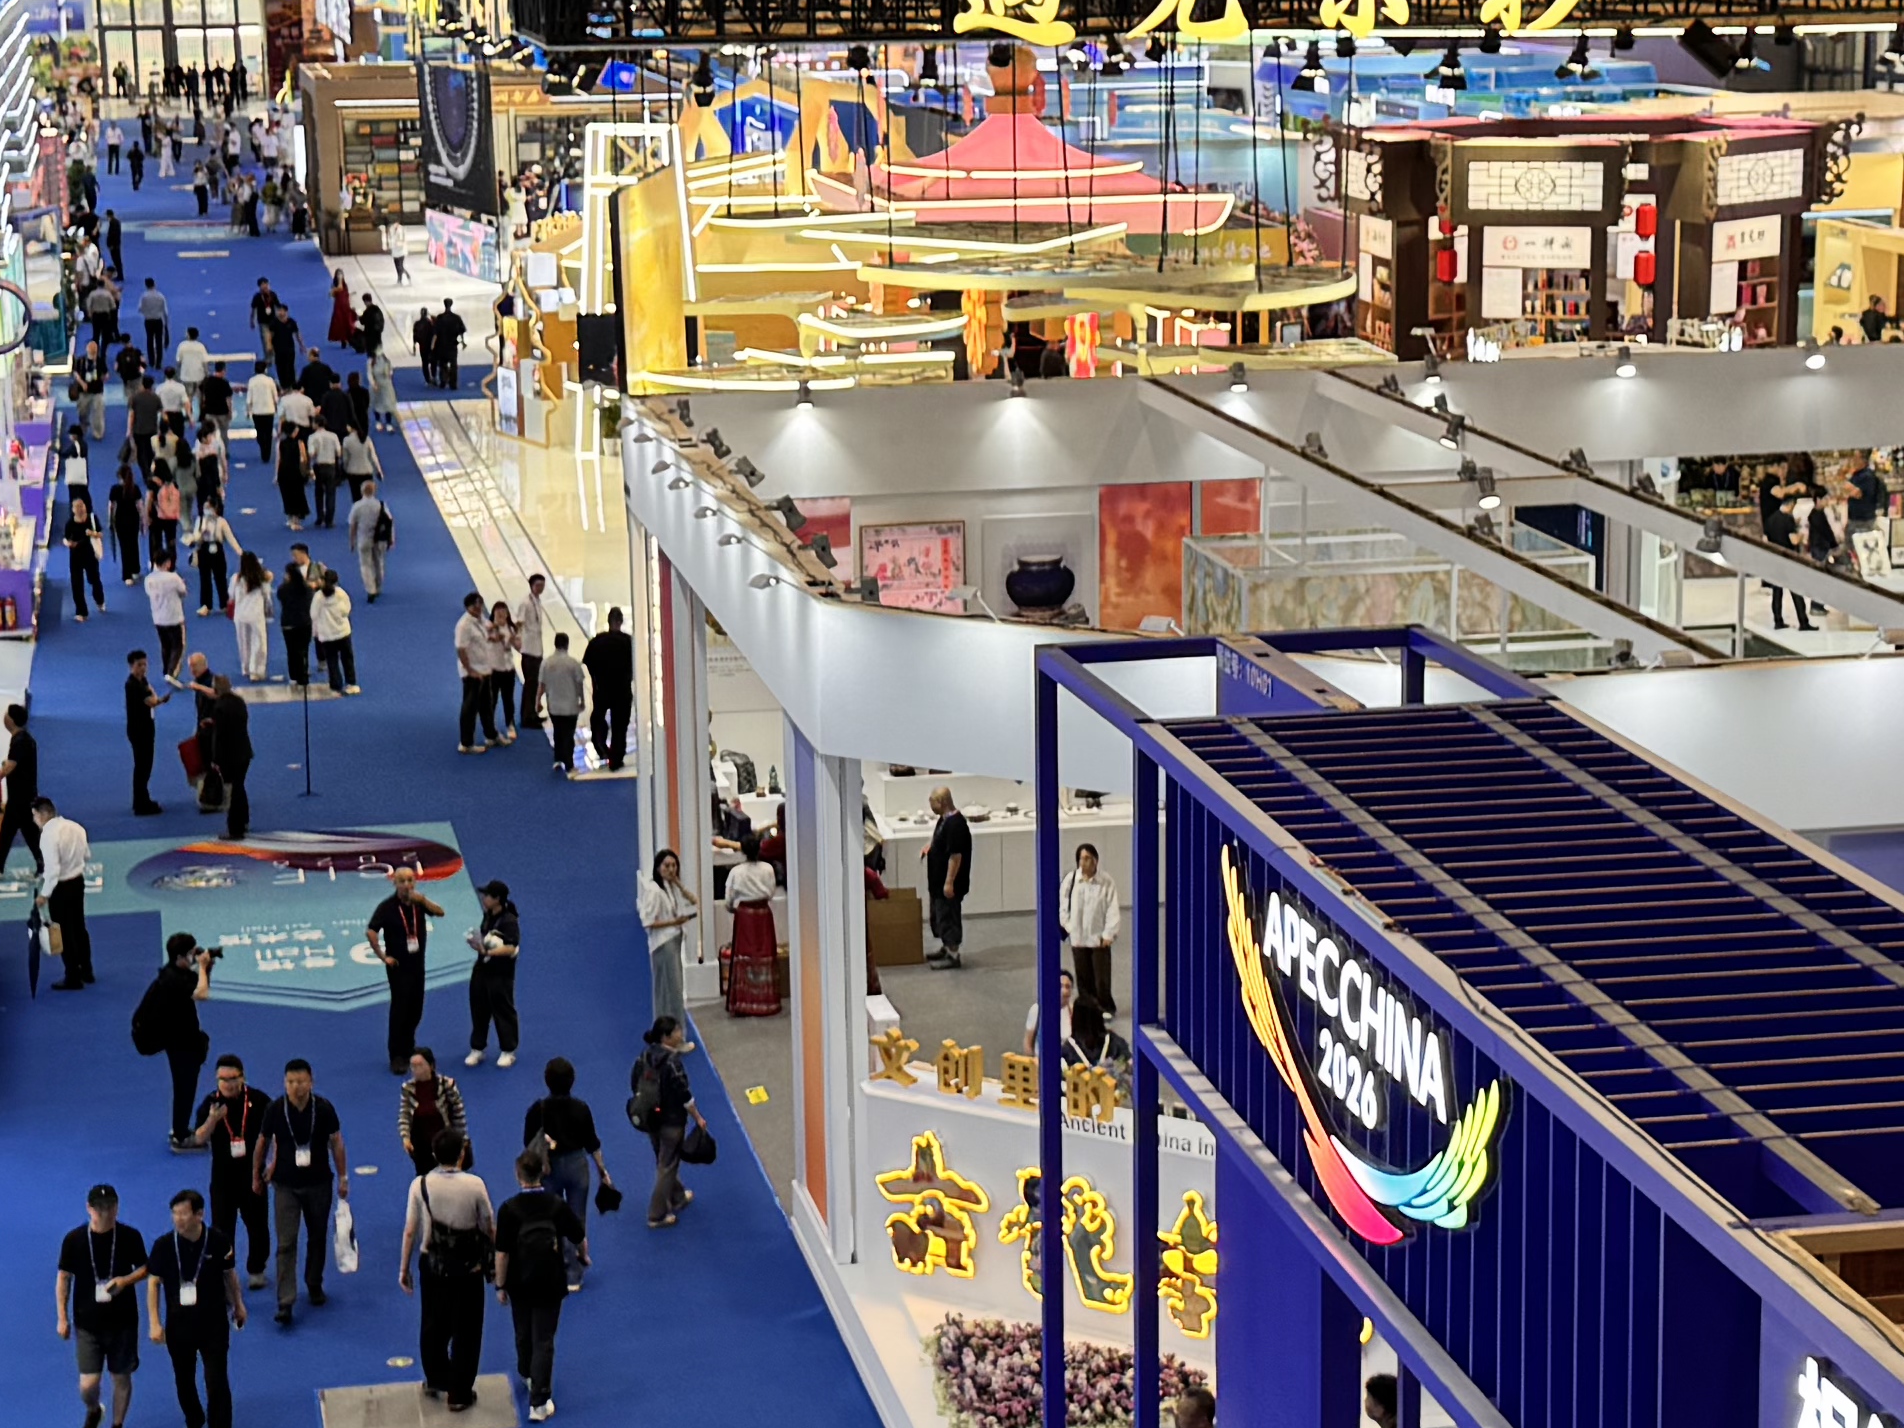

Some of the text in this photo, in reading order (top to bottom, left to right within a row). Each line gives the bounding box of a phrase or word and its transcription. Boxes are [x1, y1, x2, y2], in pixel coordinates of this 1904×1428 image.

[1263, 892, 1447, 1125] APEC CHINA
[1318, 1027, 1378, 1130] 2026
